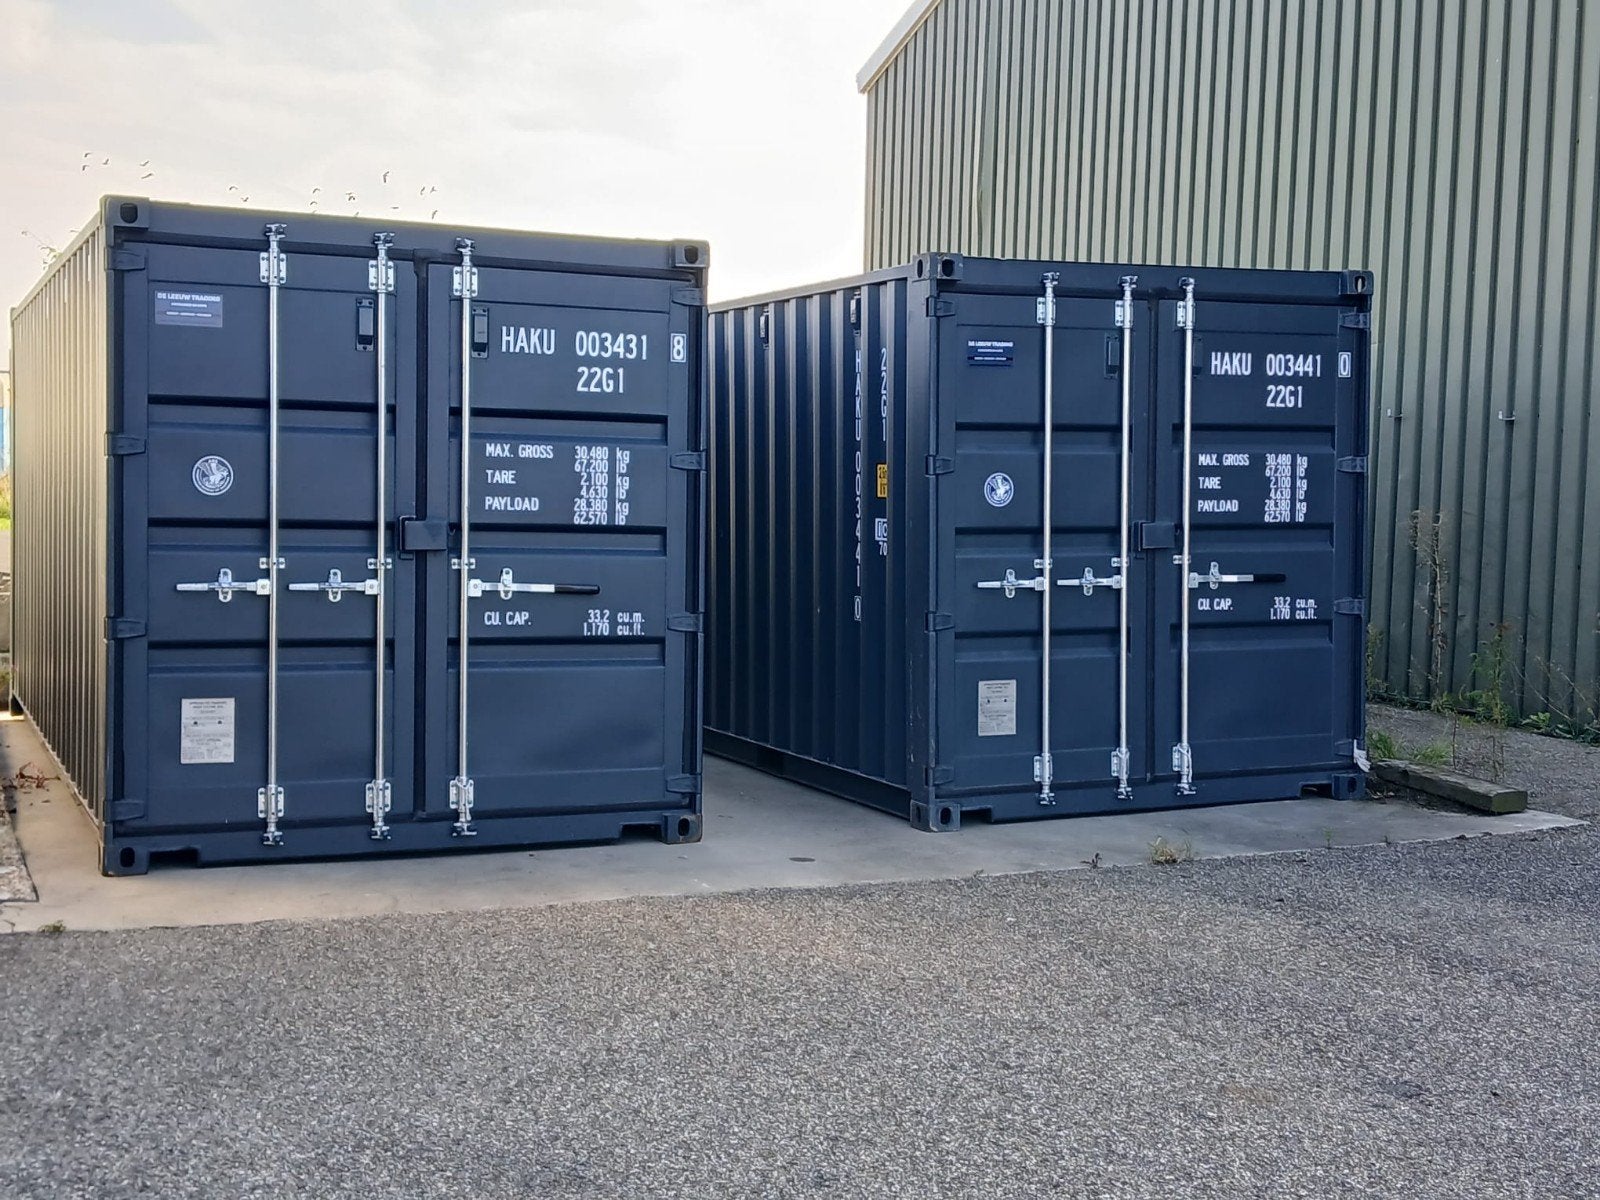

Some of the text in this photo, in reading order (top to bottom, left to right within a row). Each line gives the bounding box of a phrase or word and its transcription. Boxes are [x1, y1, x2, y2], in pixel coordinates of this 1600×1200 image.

[501, 326, 556, 355] HAKU
[575, 331, 648, 361] 003431
[1210, 351, 1253, 376] HAKU
[1265, 353, 1322, 378] 003441
[576, 366, 625, 394] 22G1
[1265, 384, 1303, 408] 22G1
[485, 442, 630, 463] MAX. GROSS 30.480 kg
[574, 459, 627, 474] 67.200 lb
[1198, 453, 1308, 469] MAX. GROSS 30.480 kg
[1265, 465, 1306, 477] 67.200 lb
[485, 469, 630, 490] TARE 2.100 kg
[1198, 476, 1308, 492] TARE 2.100 kg
[580, 485, 627, 500] 4.630 lb
[1269, 488, 1306, 500] 4.630 lb
[485, 496, 630, 516] PAYLOAD 28.380 kg
[1197, 499, 1307, 515] PAYLOAD 28.380 kg
[573, 511, 626, 526] 62.570 lb
[1264, 511, 1305, 523] 62.570 lb
[1197, 598, 1211, 611] CU.
[1213, 598, 1233, 611] CAP.
[1273, 596, 1291, 609] 33.2
[484, 609, 646, 626] CU. CAP. 33.2 cu.m.
[1270, 608, 1291, 620] 1.170
[583, 622, 609, 636] 1.170
